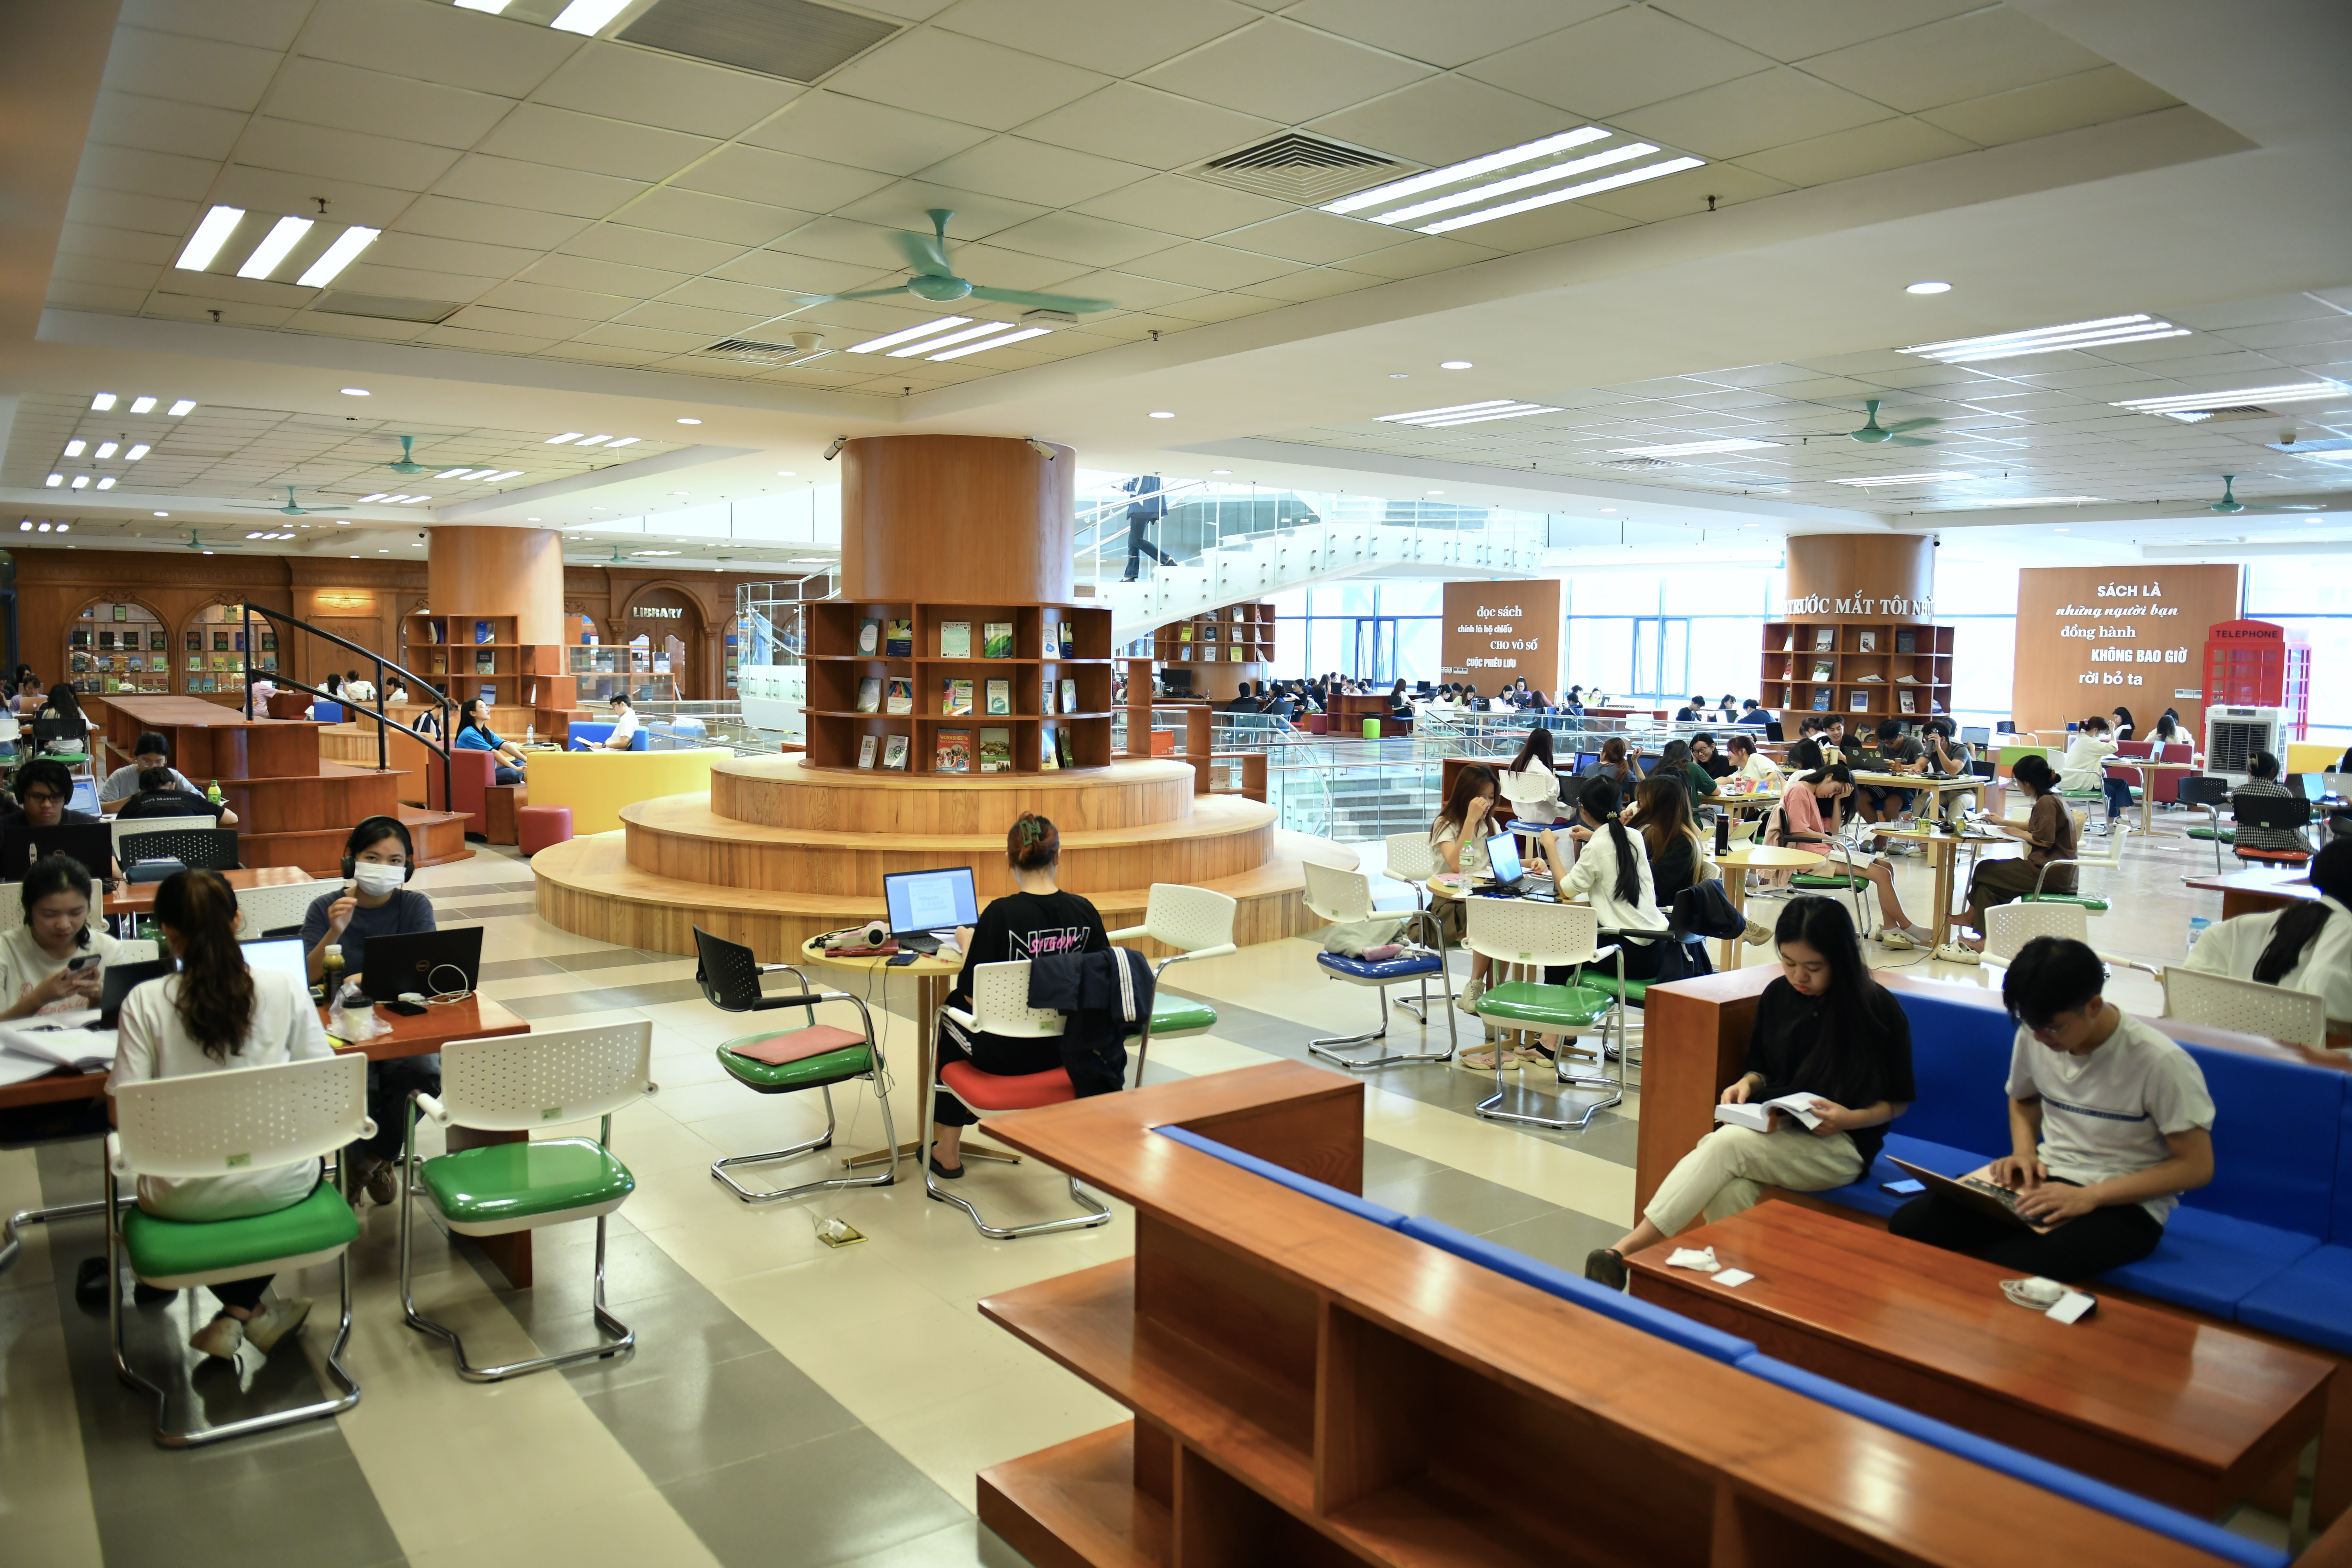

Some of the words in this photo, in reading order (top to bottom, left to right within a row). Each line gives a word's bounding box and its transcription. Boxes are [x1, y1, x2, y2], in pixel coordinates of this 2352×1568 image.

[2097, 582, 2138, 597] SÁCH
[2143, 581, 2161, 597] LÀ
[1787, 593, 1830, 614] TRƯỚC
[1835, 590, 1874, 614] MẮT
[1880, 595, 1908, 615] TÔI
[633, 607, 683, 618] LIBRARY
[1477, 606, 1495, 619] đọc
[1498, 605, 1522, 617] sách
[2056, 604, 2103, 618] những
[2104, 604, 2147, 618] người
[2150, 604, 2179, 617] bạn
[1457, 624, 1474, 633] chính
[1476, 624, 1483, 633] là
[1484, 624, 1493, 635] hộ
[1494, 623, 1512, 633] chiếu
[2061, 623, 2096, 640] đồng
[2099, 625, 2136, 638] hành
[1490, 641, 1509, 650] CHO
[1511, 639, 1524, 650] VÔ
[1526, 638, 1538, 650] SỐ
[2091, 646, 2133, 662] KHÔNG
[2136, 650, 2161, 663] BAO
[2165, 647, 2188, 663] GIỜ
[1466, 657, 1483, 669] CUỘC
[1484, 657, 1502, 668] PHIÊU
[1503, 658, 1516, 668] LƯU
[2079, 671, 2099, 684] rời
[2103, 671, 2123, 685] bỏ
[2127, 673, 2143, 685] ta
